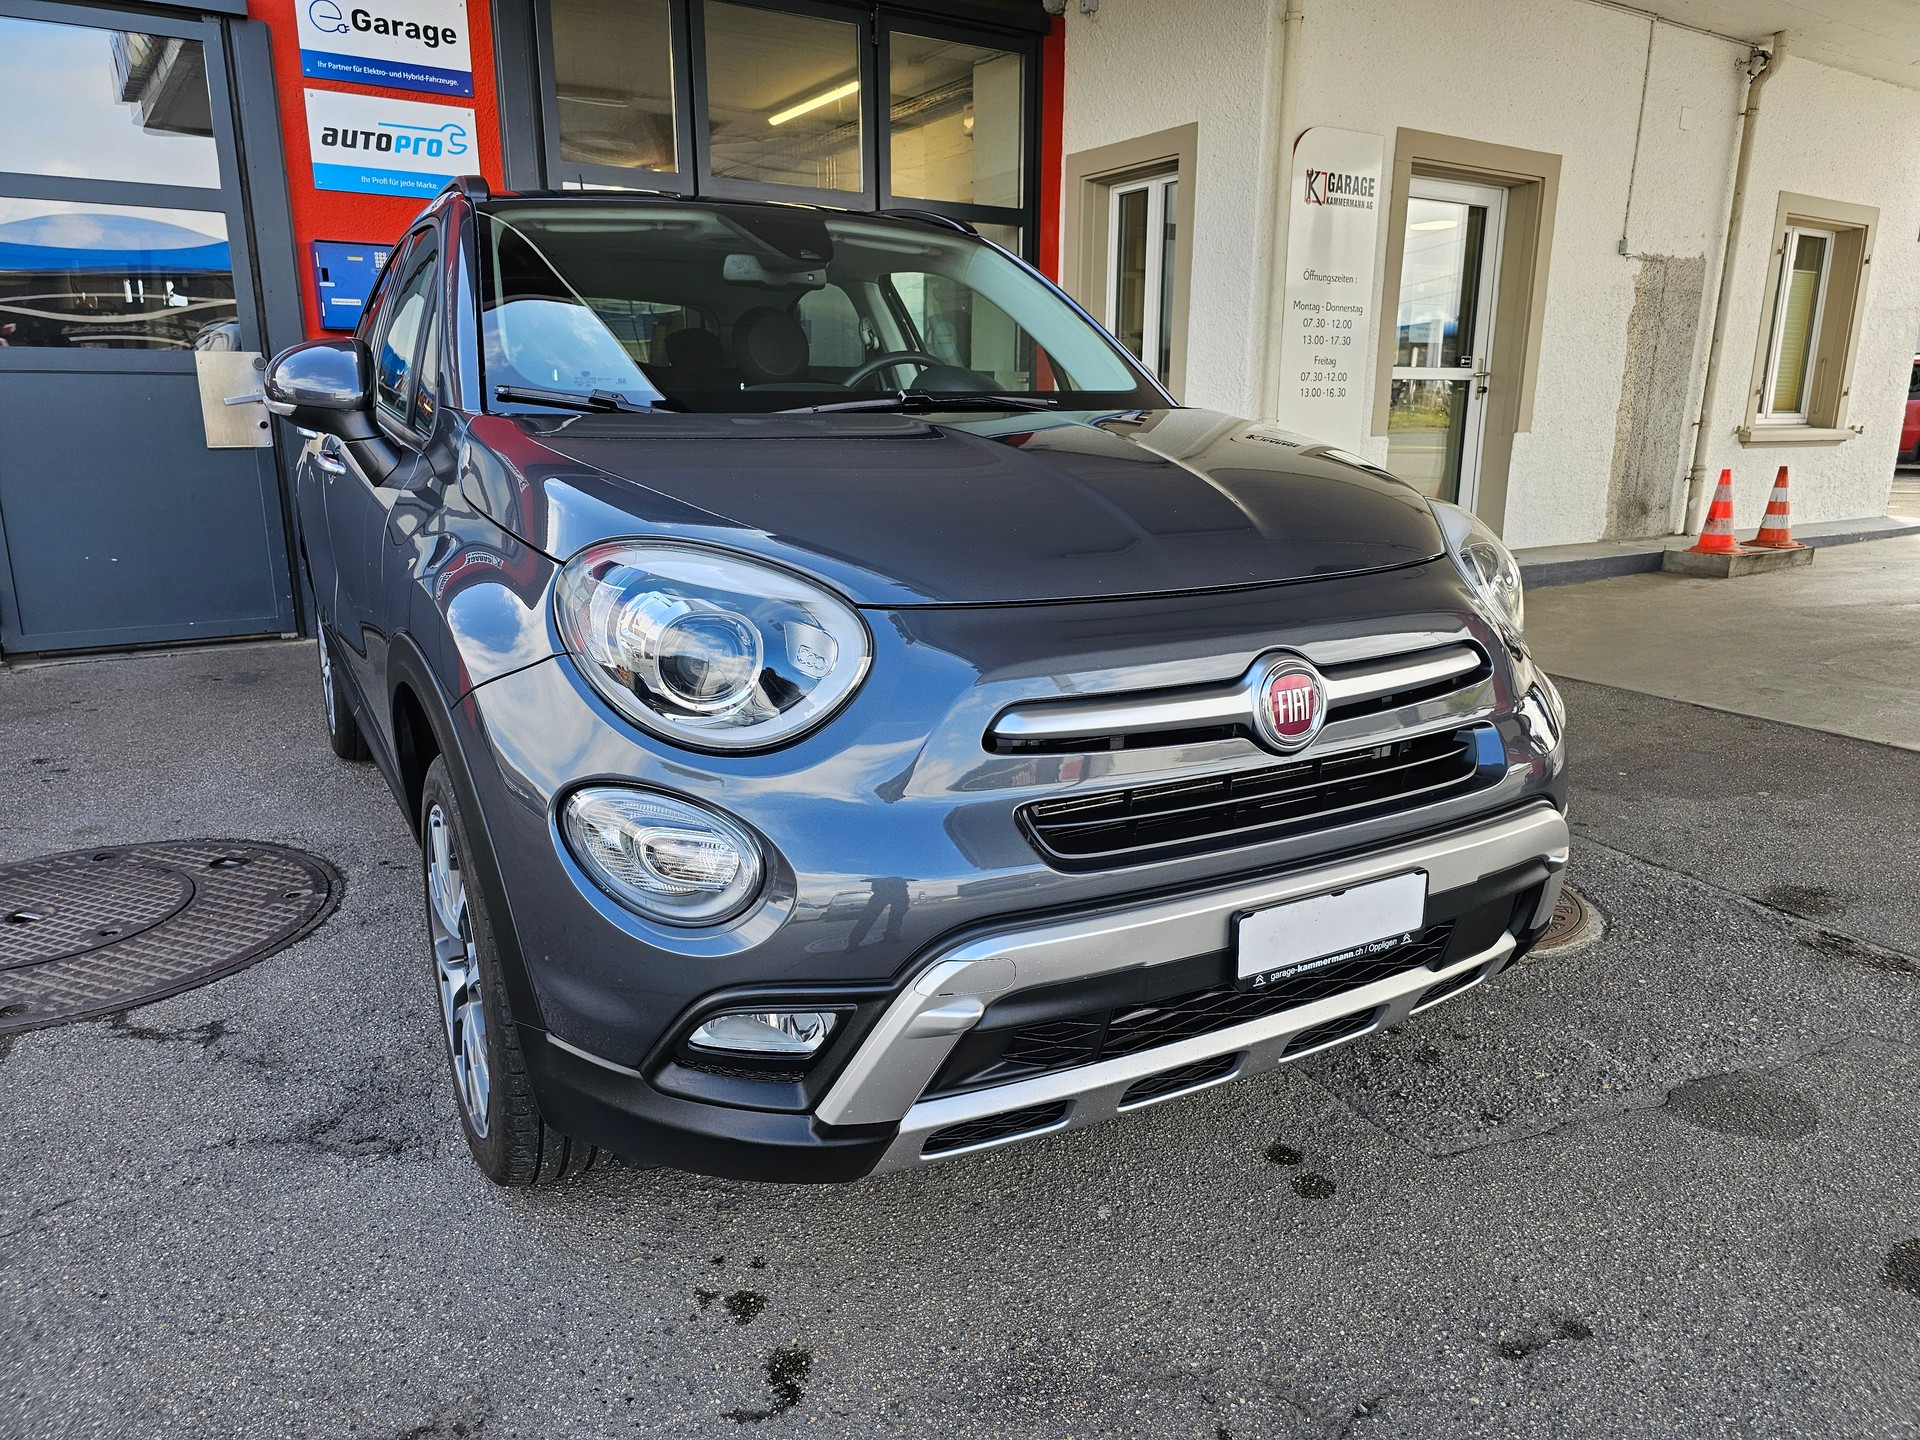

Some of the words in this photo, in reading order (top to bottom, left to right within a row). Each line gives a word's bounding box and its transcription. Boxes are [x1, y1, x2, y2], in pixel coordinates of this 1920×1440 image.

[351, 9, 457, 48] Garage
[317, 60, 327, 68] Ihr
[328, 62, 352, 72] Partner
[353, 65, 363, 73] für
[363, 67, 388, 77] Elektro-
[389, 70, 402, 79] und
[403, 72, 459, 87] Hybrid-Fahrzeuge.
[372, 177, 388, 185] Profi
[389, 178, 399, 186] für
[400, 180, 415, 188] jede
[416, 181, 439, 190] Marke.
[1327, 172, 1375, 198] GARAGE
[1326, 196, 1365, 209] KAMMERMANN
[1366, 201, 1373, 210] AG
[1303, 268, 1354, 284] Öffnungszeiten
[1293, 300, 1320, 314] Montag
[1325, 301, 1363, 315] Donnerstag
[1303, 317, 1326, 328] 07.30
[1331, 319, 1352, 329] 12.00
[1303, 335, 1325, 345] 13.00
[1330, 336, 1351, 346] 17.30
[1314, 355, 1337, 368] Freitag
[1300, 371, 1323, 382] 07.30
[1300, 387, 1322, 398] 13.00
[1277, 686, 1312, 725] FIAT
[1270, 949, 1364, 982] garage-kammermann.ch
[1369, 938, 1398, 954] Oppligen
